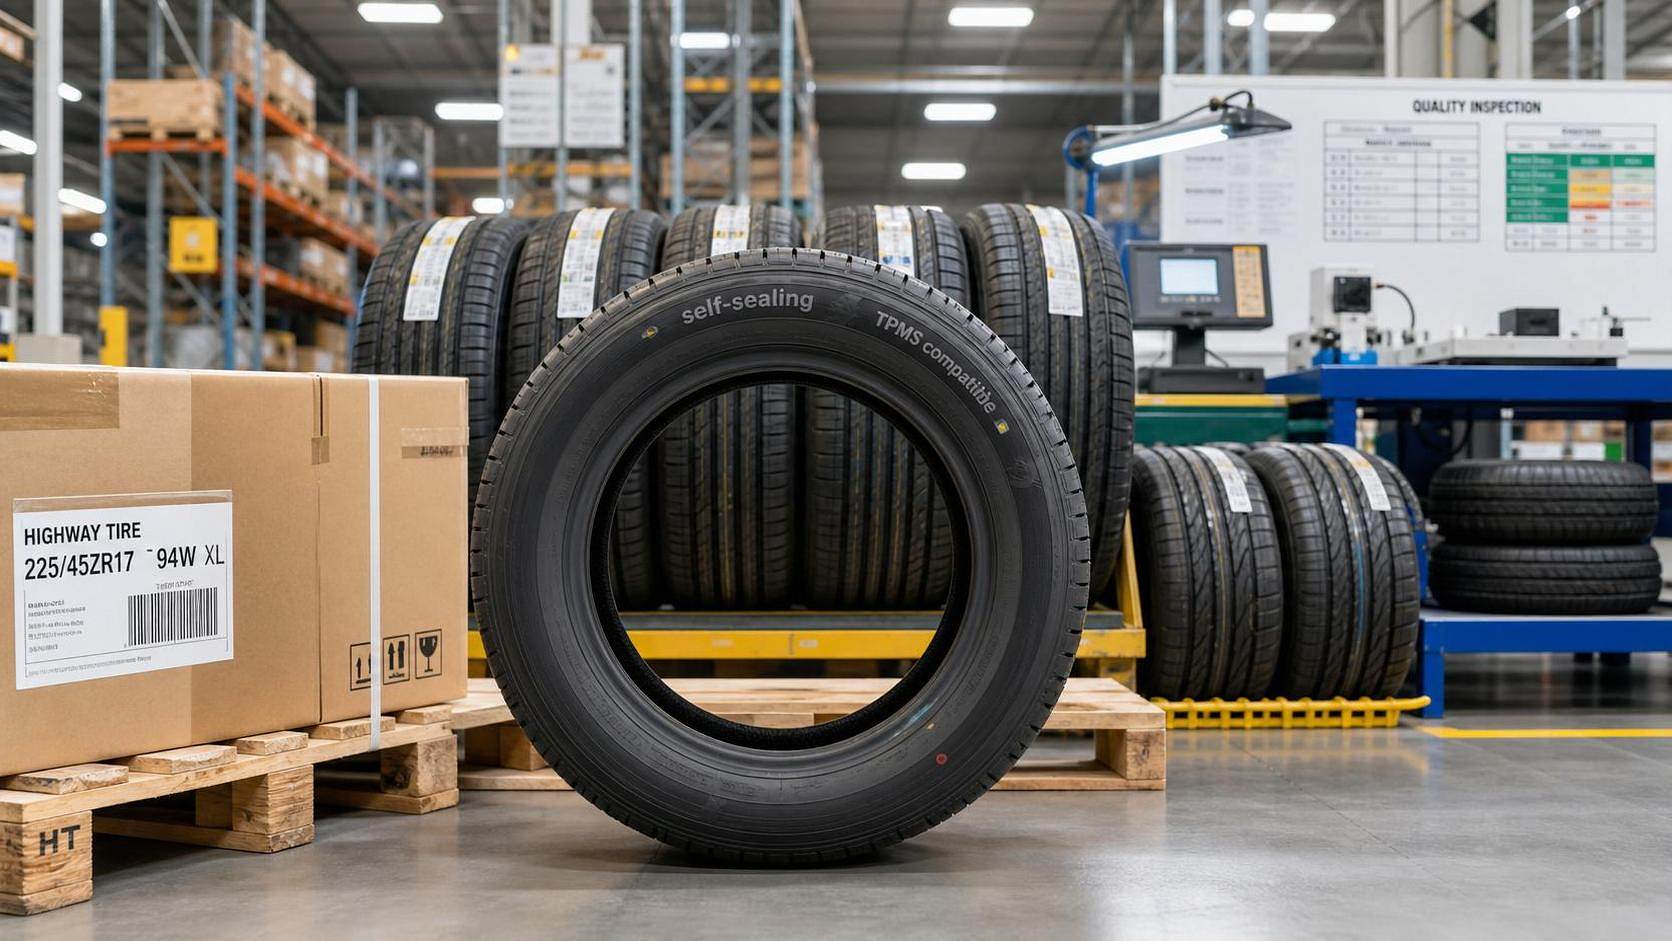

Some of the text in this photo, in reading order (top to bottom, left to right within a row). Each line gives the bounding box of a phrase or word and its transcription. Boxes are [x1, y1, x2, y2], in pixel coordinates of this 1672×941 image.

[1413, 100, 1542, 114] QUALITY INSPECTION
[681, 288, 814, 324] self-sealing
[875, 311, 924, 346] TPMS
[24, 521, 142, 546] HIGHWAY TIRE
[25, 550, 135, 580] 225/45ZR17
[204, 544, 225, 566] XL
[39, 824, 81, 856] HT
